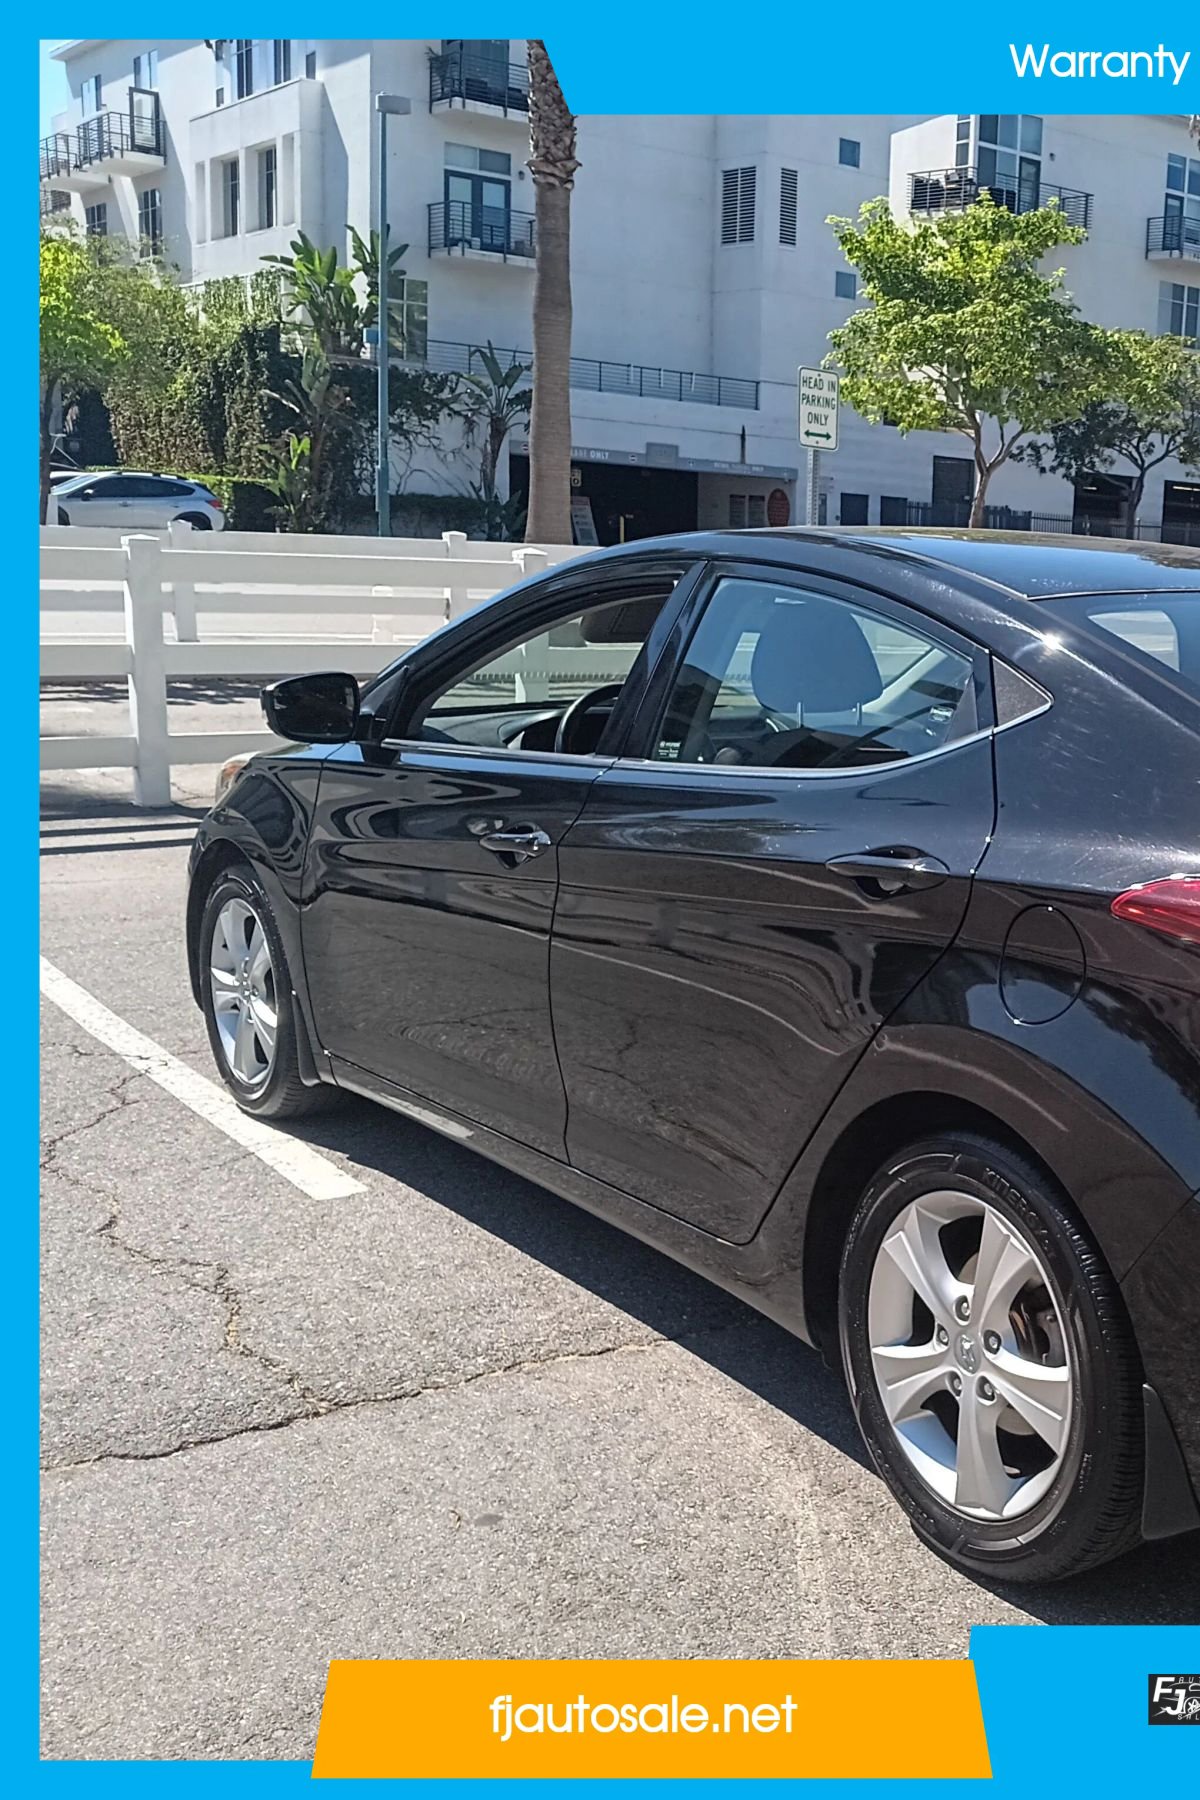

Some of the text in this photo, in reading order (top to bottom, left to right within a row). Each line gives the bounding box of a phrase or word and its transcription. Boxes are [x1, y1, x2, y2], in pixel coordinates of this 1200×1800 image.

[802, 376, 836, 392] HEAD IN
[801, 393, 836, 410] PARKING
[807, 411, 829, 425] ONLY
